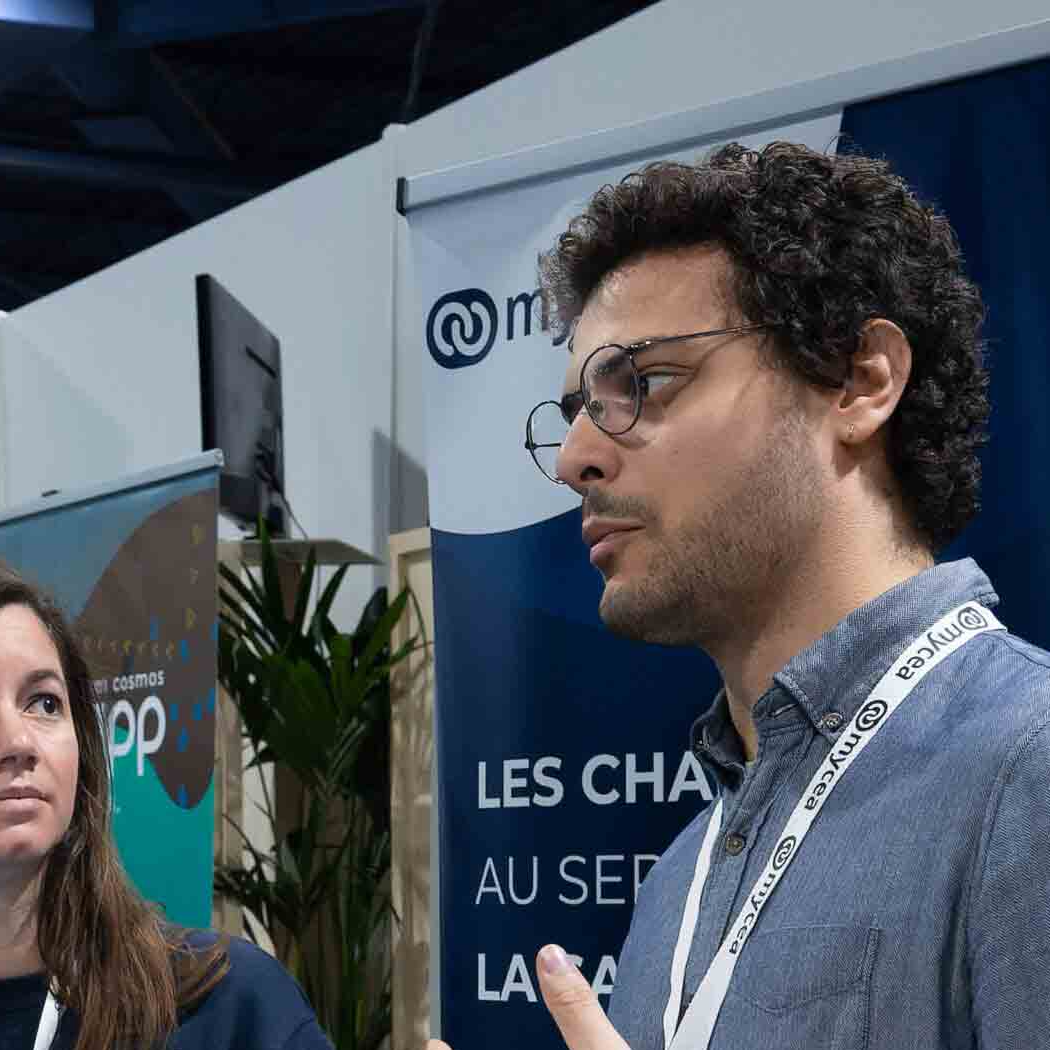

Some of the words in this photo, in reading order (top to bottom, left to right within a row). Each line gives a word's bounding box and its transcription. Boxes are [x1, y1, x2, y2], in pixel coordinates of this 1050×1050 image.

[896, 622, 963, 681] mycea
[112, 670, 165, 692] cosmos
[478, 756, 564, 809] LES
[804, 731, 862, 811] mycea
[475, 855, 538, 905] AU
[729, 872, 775, 955] mycea
[477, 953, 538, 1003] LA
